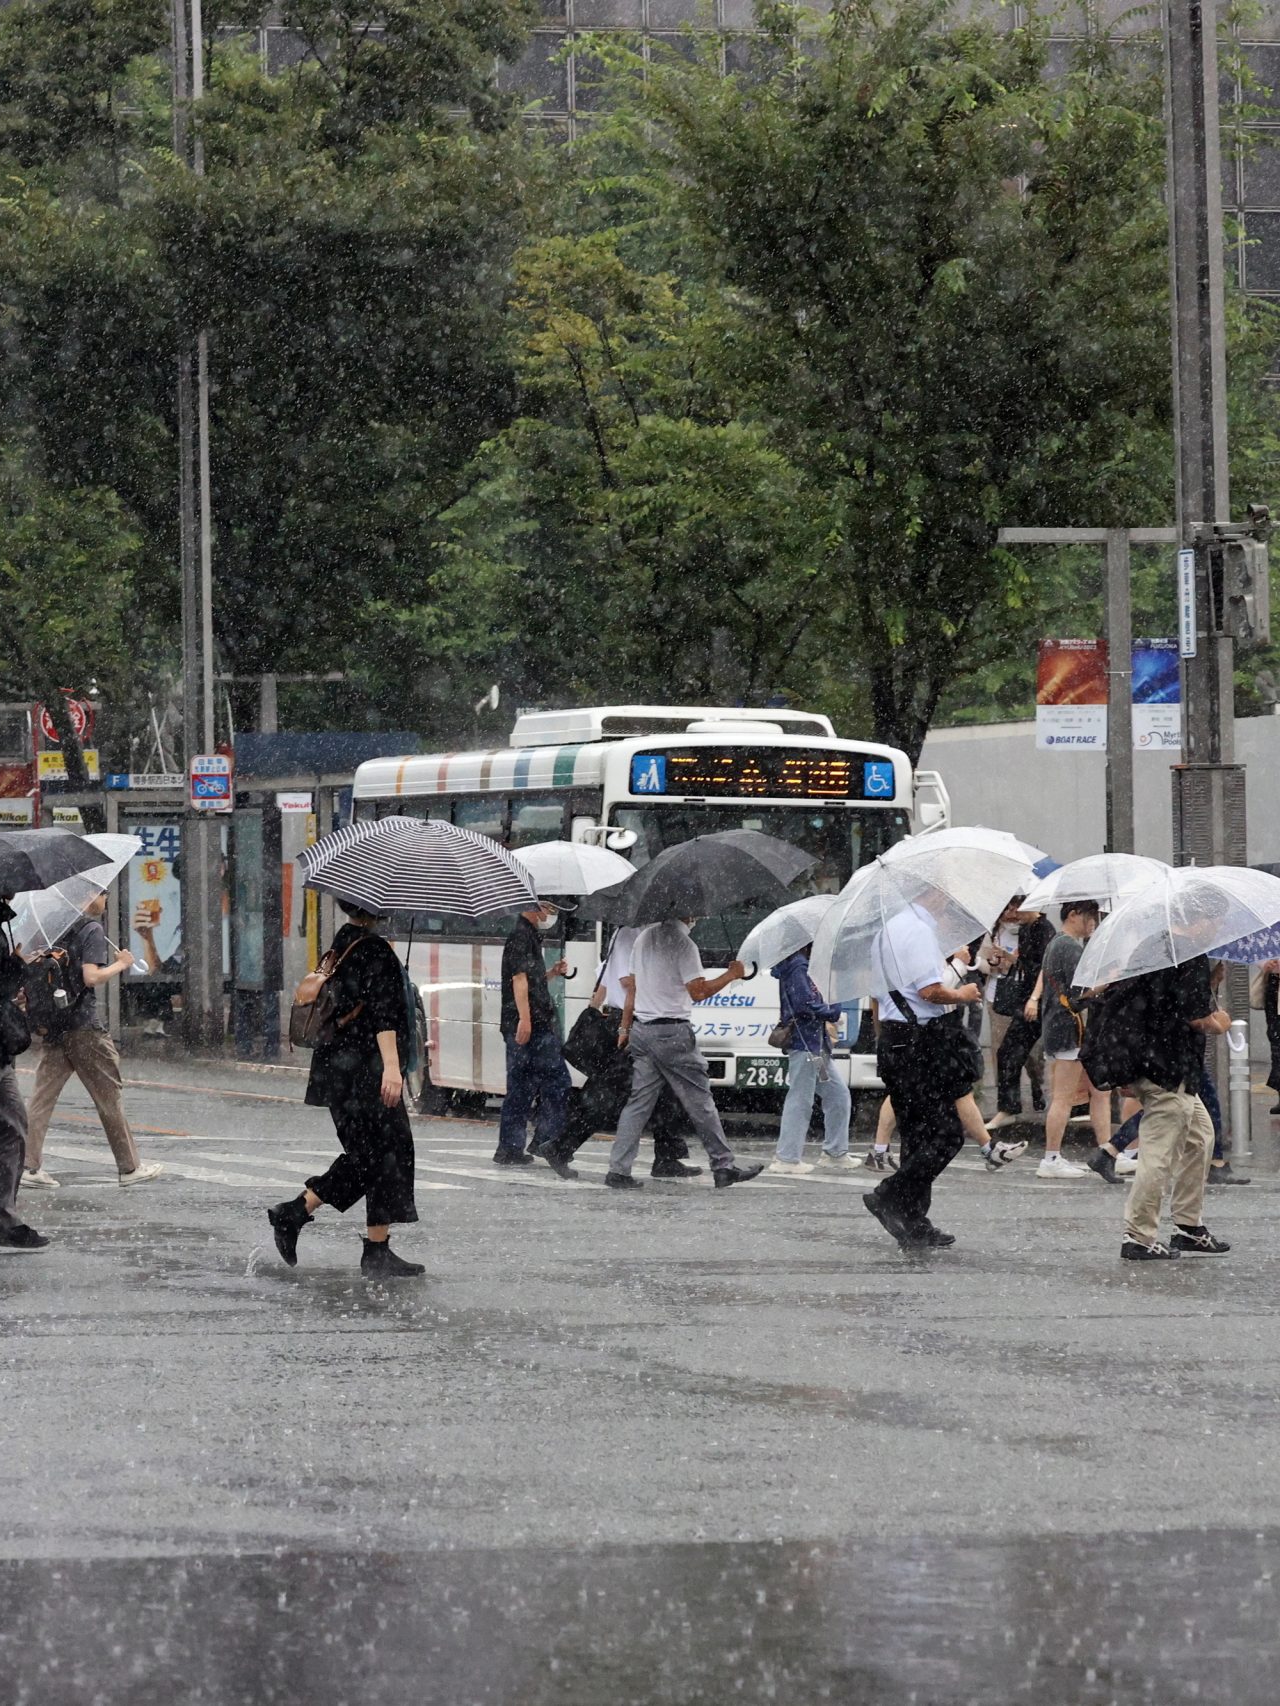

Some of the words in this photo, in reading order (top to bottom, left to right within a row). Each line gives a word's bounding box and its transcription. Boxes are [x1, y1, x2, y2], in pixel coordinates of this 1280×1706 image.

[1055, 735, 1075, 744] BOAT
[1076, 735, 1097, 744] RACE
[112, 775, 120, 786] F
